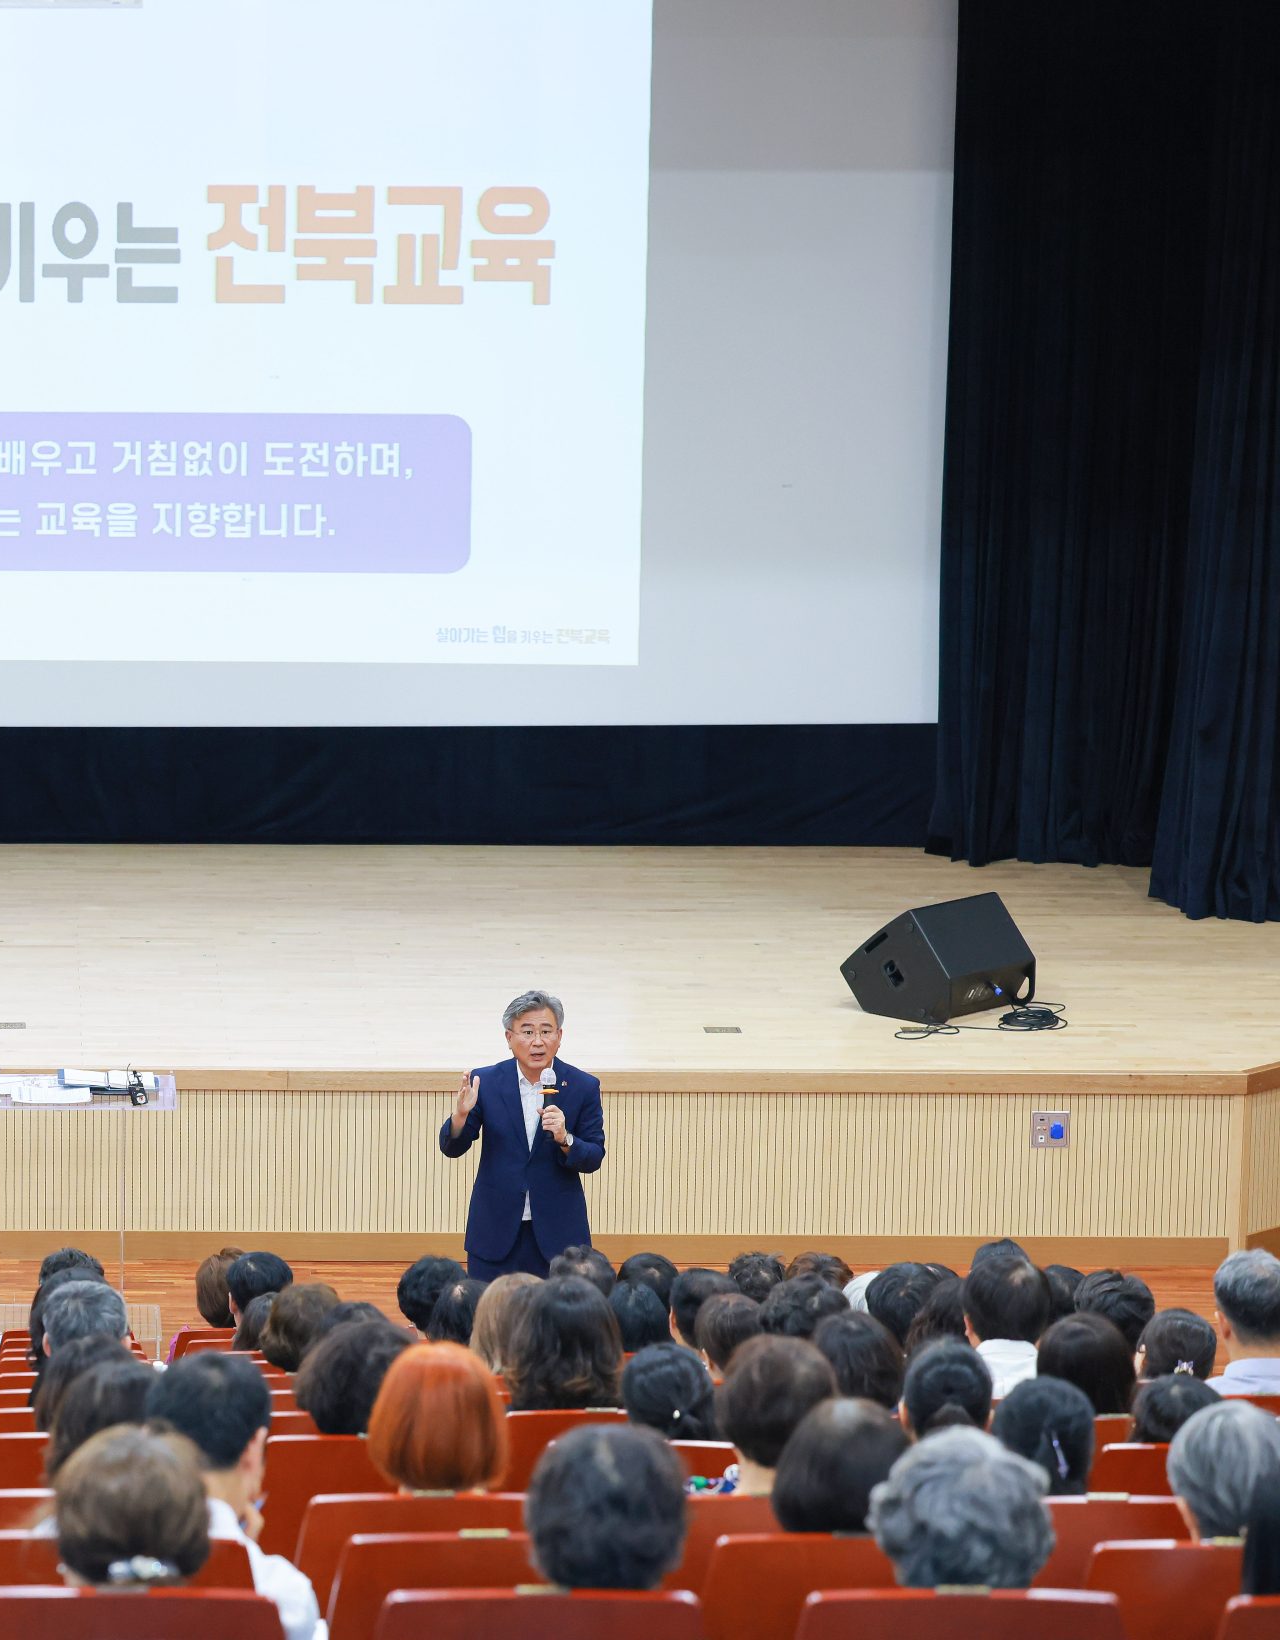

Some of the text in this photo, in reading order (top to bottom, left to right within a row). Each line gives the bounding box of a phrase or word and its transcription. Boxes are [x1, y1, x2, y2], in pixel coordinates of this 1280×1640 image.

[206, 184, 556, 306] 전북교육
[112, 440, 248, 477] 거침없이
[264, 441, 412, 479] 도전하며,
[36, 502, 137, 538] 교육을
[152, 503, 336, 538] 지향합니다.
